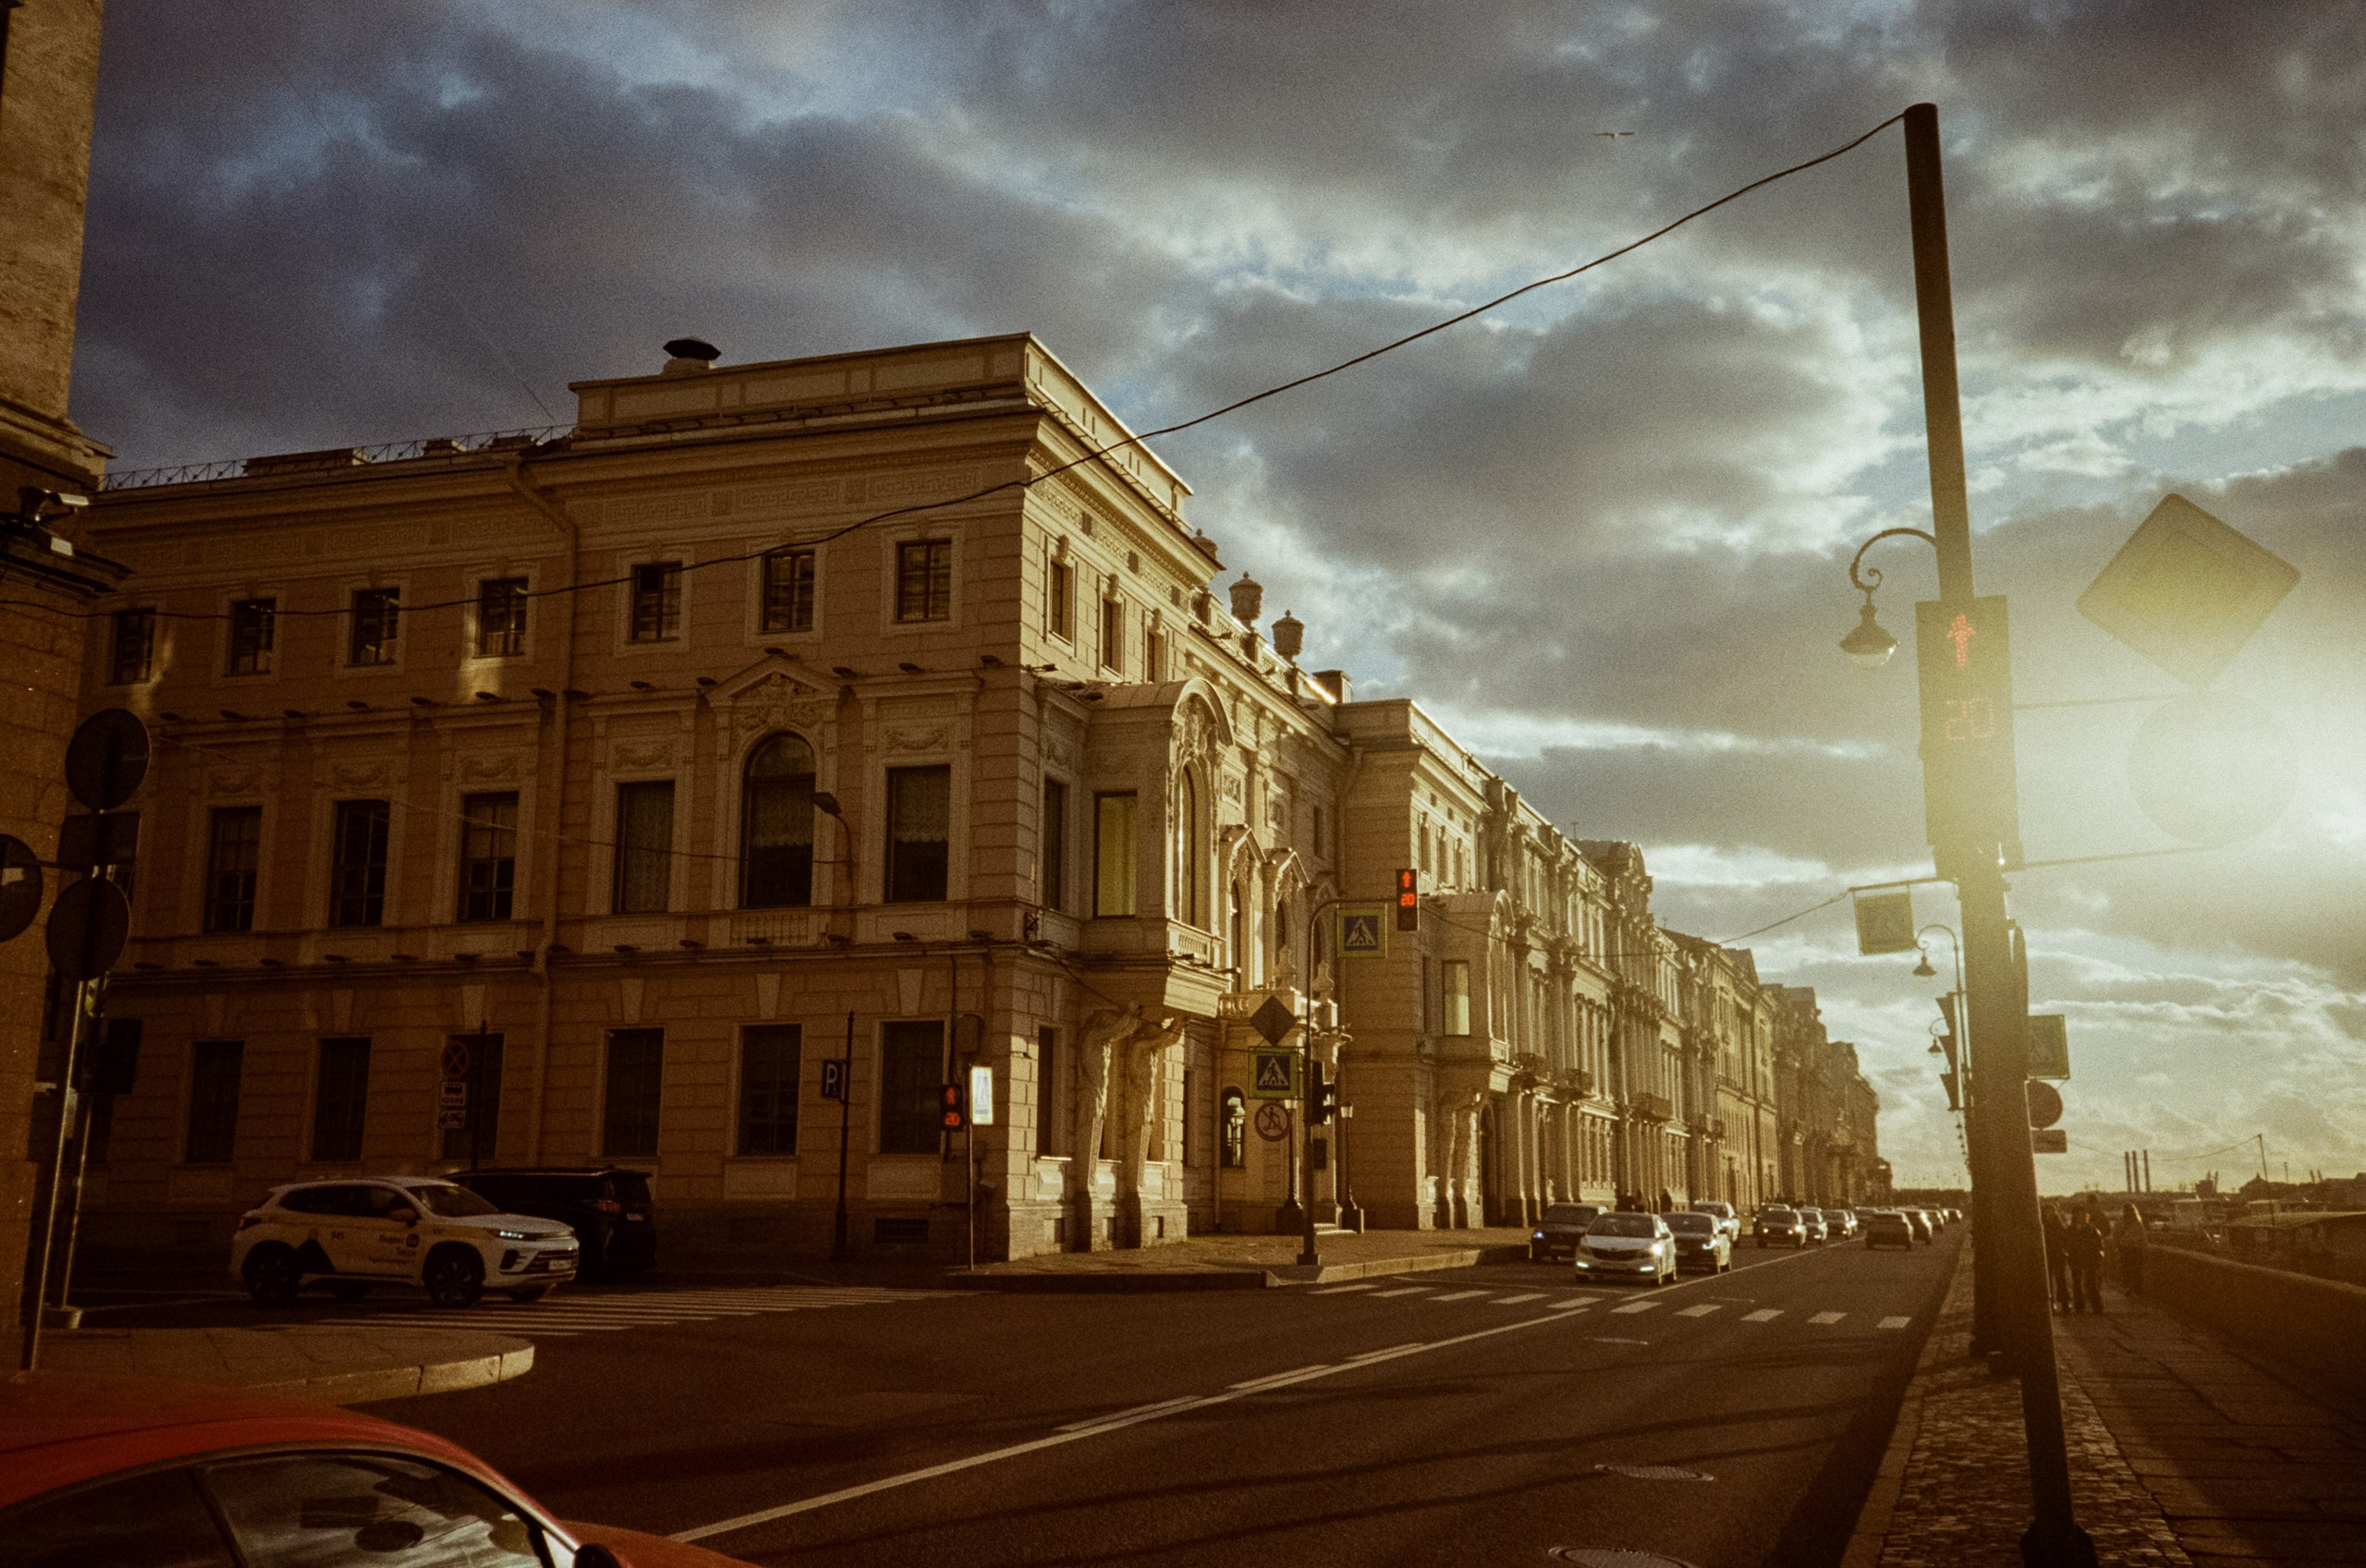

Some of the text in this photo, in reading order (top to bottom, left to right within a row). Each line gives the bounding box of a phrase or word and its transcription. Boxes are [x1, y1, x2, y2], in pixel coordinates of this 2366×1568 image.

[1944, 697, 1994, 740] 20
[1400, 893, 1415, 906] 20
[826, 1064, 837, 1094] P
[945, 1112, 959, 1125] 20
